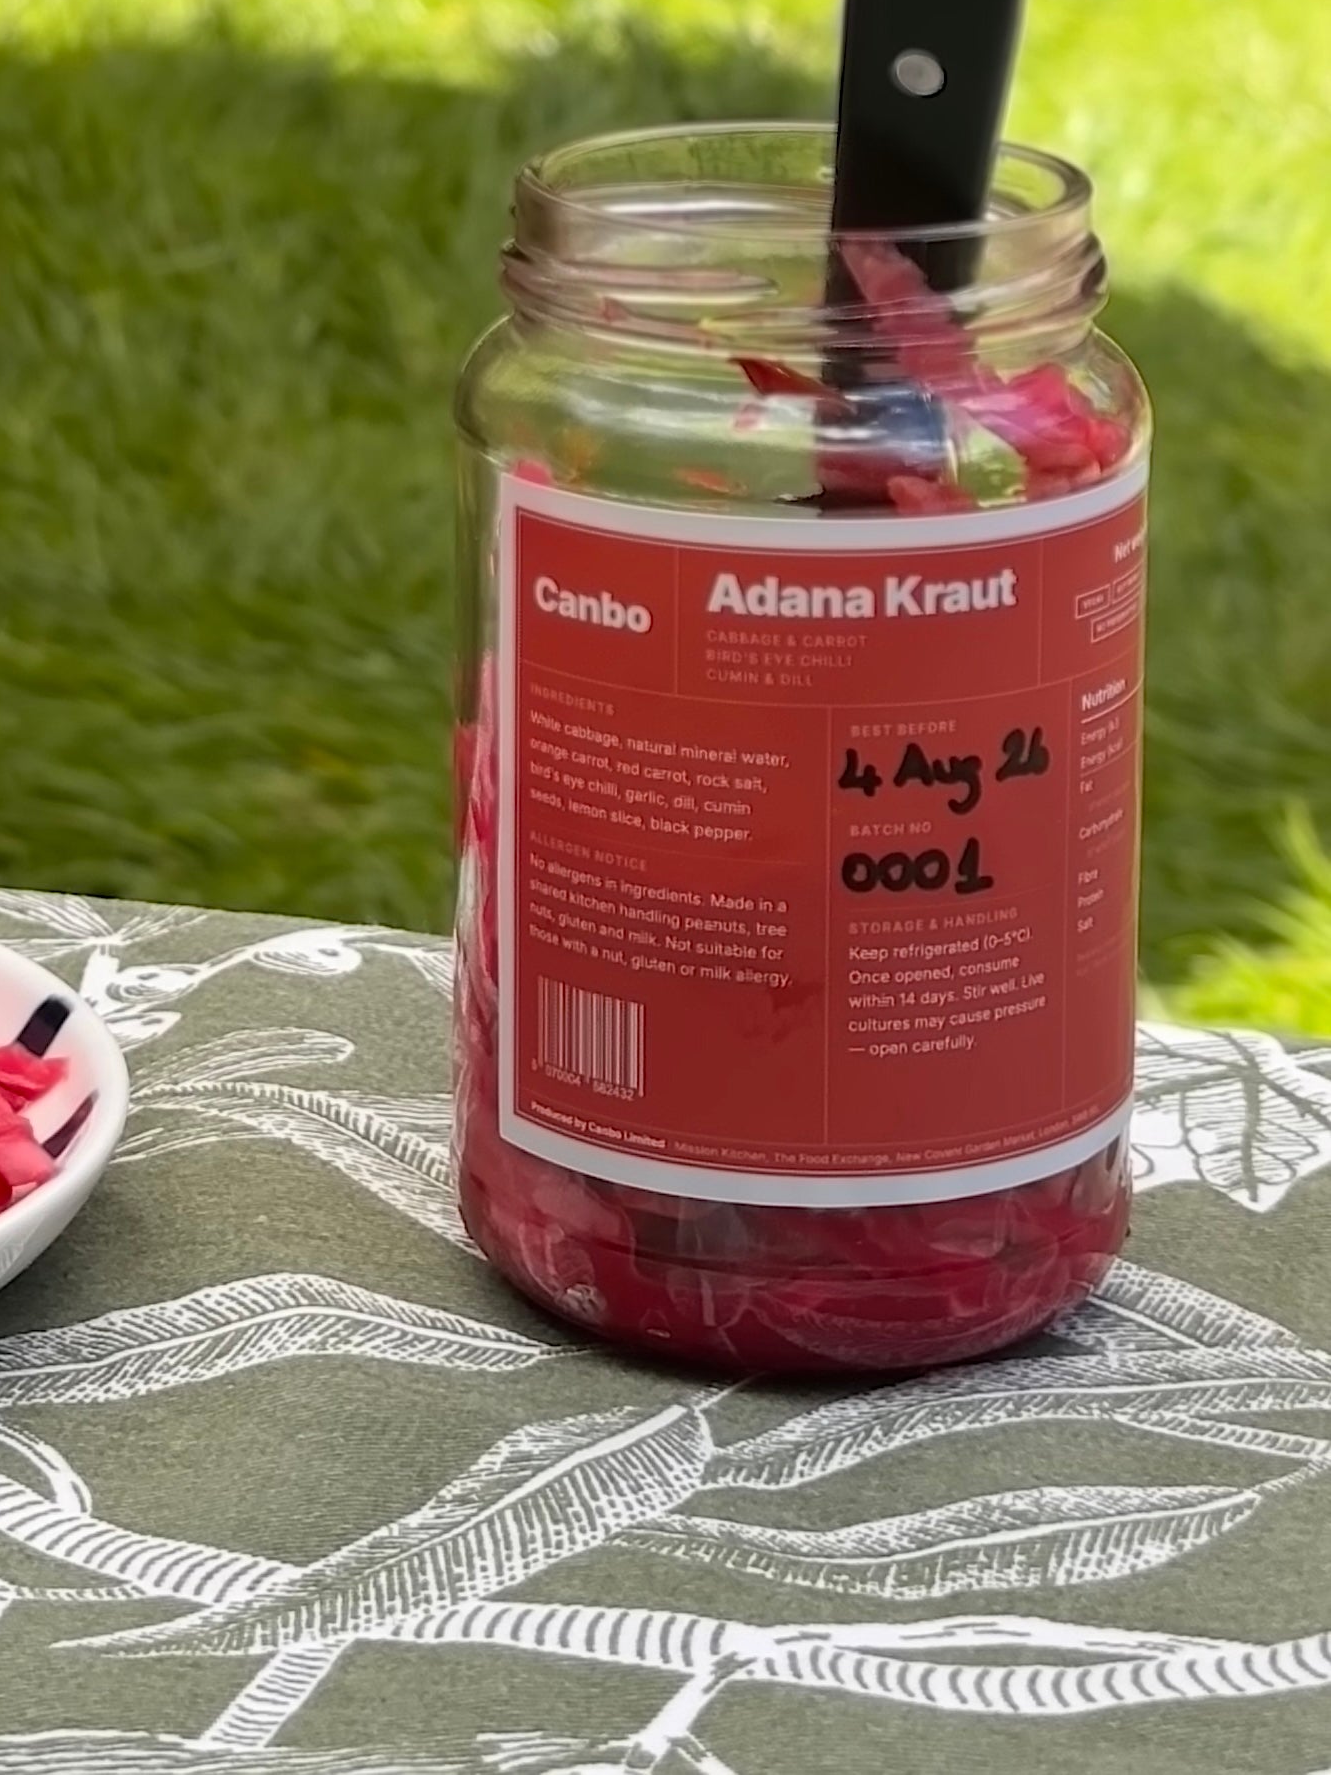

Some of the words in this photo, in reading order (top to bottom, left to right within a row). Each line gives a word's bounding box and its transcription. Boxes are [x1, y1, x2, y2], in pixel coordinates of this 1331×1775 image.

[535, 576, 654, 634] Canbo
[706, 572, 876, 619] Adana
[884, 568, 1018, 617] Kraut
[705, 649, 759, 666] BIRD'S
[764, 652, 794, 666] EYE
[800, 654, 853, 669] CHILLI
[706, 629, 782, 647] CABBAGE
[786, 634, 797, 647] &
[802, 634, 868, 649] CARROT
[706, 668, 760, 685] CUMIN
[764, 672, 774, 686] &
[780, 673, 814, 688] DILL
[1081, 679, 1126, 711] Nutrition
[530, 683, 615, 716] INGREDIENTS
[530, 710, 562, 732] White
[564, 724, 623, 749] cabbage,
[627, 737, 677, 756] natural
[681, 745, 736, 763] mineral
[741, 752, 789, 768] water,
[850, 724, 892, 738] BEST
[897, 720, 957, 737] BEFORE
[530, 738, 568, 760] orange
[571, 751, 613, 772] carrot,
[617, 761, 640, 776] red
[644, 767, 691, 786] carrot,
[697, 774, 730, 788] rock
[735, 776, 767, 794] salt,
[838, 748, 883, 797] 4
[893, 742, 983, 816] Aug
[995, 726, 1050, 782] 26
[530, 761, 560, 782] bird's
[563, 774, 585, 790] eye
[588, 779, 621, 800] chilli,
[626, 787, 668, 809] garlic,
[673, 795, 699, 813] dill,
[704, 800, 751, 815] cumin
[530, 788, 565, 811] seeds,
[569, 800, 607, 819] lemon
[610, 809, 645, 830] slice,
[650, 816, 690, 834] black
[694, 825, 753, 842] pepper.
[850, 824, 905, 838] BATCH
[909, 821, 932, 835] NO
[530, 830, 590, 859] ALLERGEN
[594, 850, 647, 871] NOTICE
[842, 837, 994, 894] 0001
[530, 852, 545, 869] No
[548, 861, 602, 887] allergens
[605, 876, 617, 890] in
[620, 879, 705, 907] ingredients.
[710, 894, 755, 911] Made
[759, 898, 773, 912] in
[777, 901, 788, 913] a
[530, 879, 567, 901] shared
[569, 892, 616, 914] kitchen
[620, 903, 680, 929] handling
[684, 915, 751, 936] peanuts,
[756, 922, 788, 937] tree
[849, 918, 924, 935] STORAGE
[929, 919, 939, 931] &
[944, 907, 1018, 929] HANDLING
[530, 902, 555, 922] nuts,
[558, 912, 596, 934] gluten
[599, 924, 624, 939] and
[628, 930, 661, 947] milk.
[665, 936, 691, 952] Not
[695, 942, 757, 959] suitable
[761, 946, 784, 960] for
[849, 947, 889, 962] Keep
[893, 938, 980, 961] refrigerated
[529, 924, 559, 945] those
[562, 936, 587, 955] with
[590, 946, 599, 958] a
[602, 948, 628, 966] nut,
[631, 954, 676, 974] gluten
[680, 964, 696, 976] or
[700, 966, 732, 980] milk
[736, 969, 793, 988] allergy.
[849, 970, 891, 985] Once
[895, 965, 955, 985] opened,
[959, 955, 1020, 977] consume
[849, 993, 895, 1009] within
[899, 992, 916, 1006] 14
[920, 989, 959, 1006] days.
[963, 984, 986, 1001] Stir
[989, 978, 1018, 996] well.
[1021, 972, 1045, 989] Live
[849, 1017, 910, 1032] cultures
[915, 1014, 945, 1031] may
[949, 1008, 991, 1026] cause
[994, 995, 1046, 1021] pressure
[869, 1041, 908, 1058] open
[912, 1035, 977, 1055] carefully.
[531, 1100, 573, 1125] Produced
[574, 1116, 587, 1132] by
[588, 1121, 622, 1141] Canbo
[624, 1130, 666, 1149] Limited
[674, 1141, 719, 1157] Mission
[774, 1152, 796, 1164] The
[799, 1152, 829, 1165] Food
[832, 1153, 893, 1167] Exchange,
[896, 1151, 920, 1163] New
[924, 1145, 963, 1161] Covent
[965, 1139, 1002, 1156] Garden
